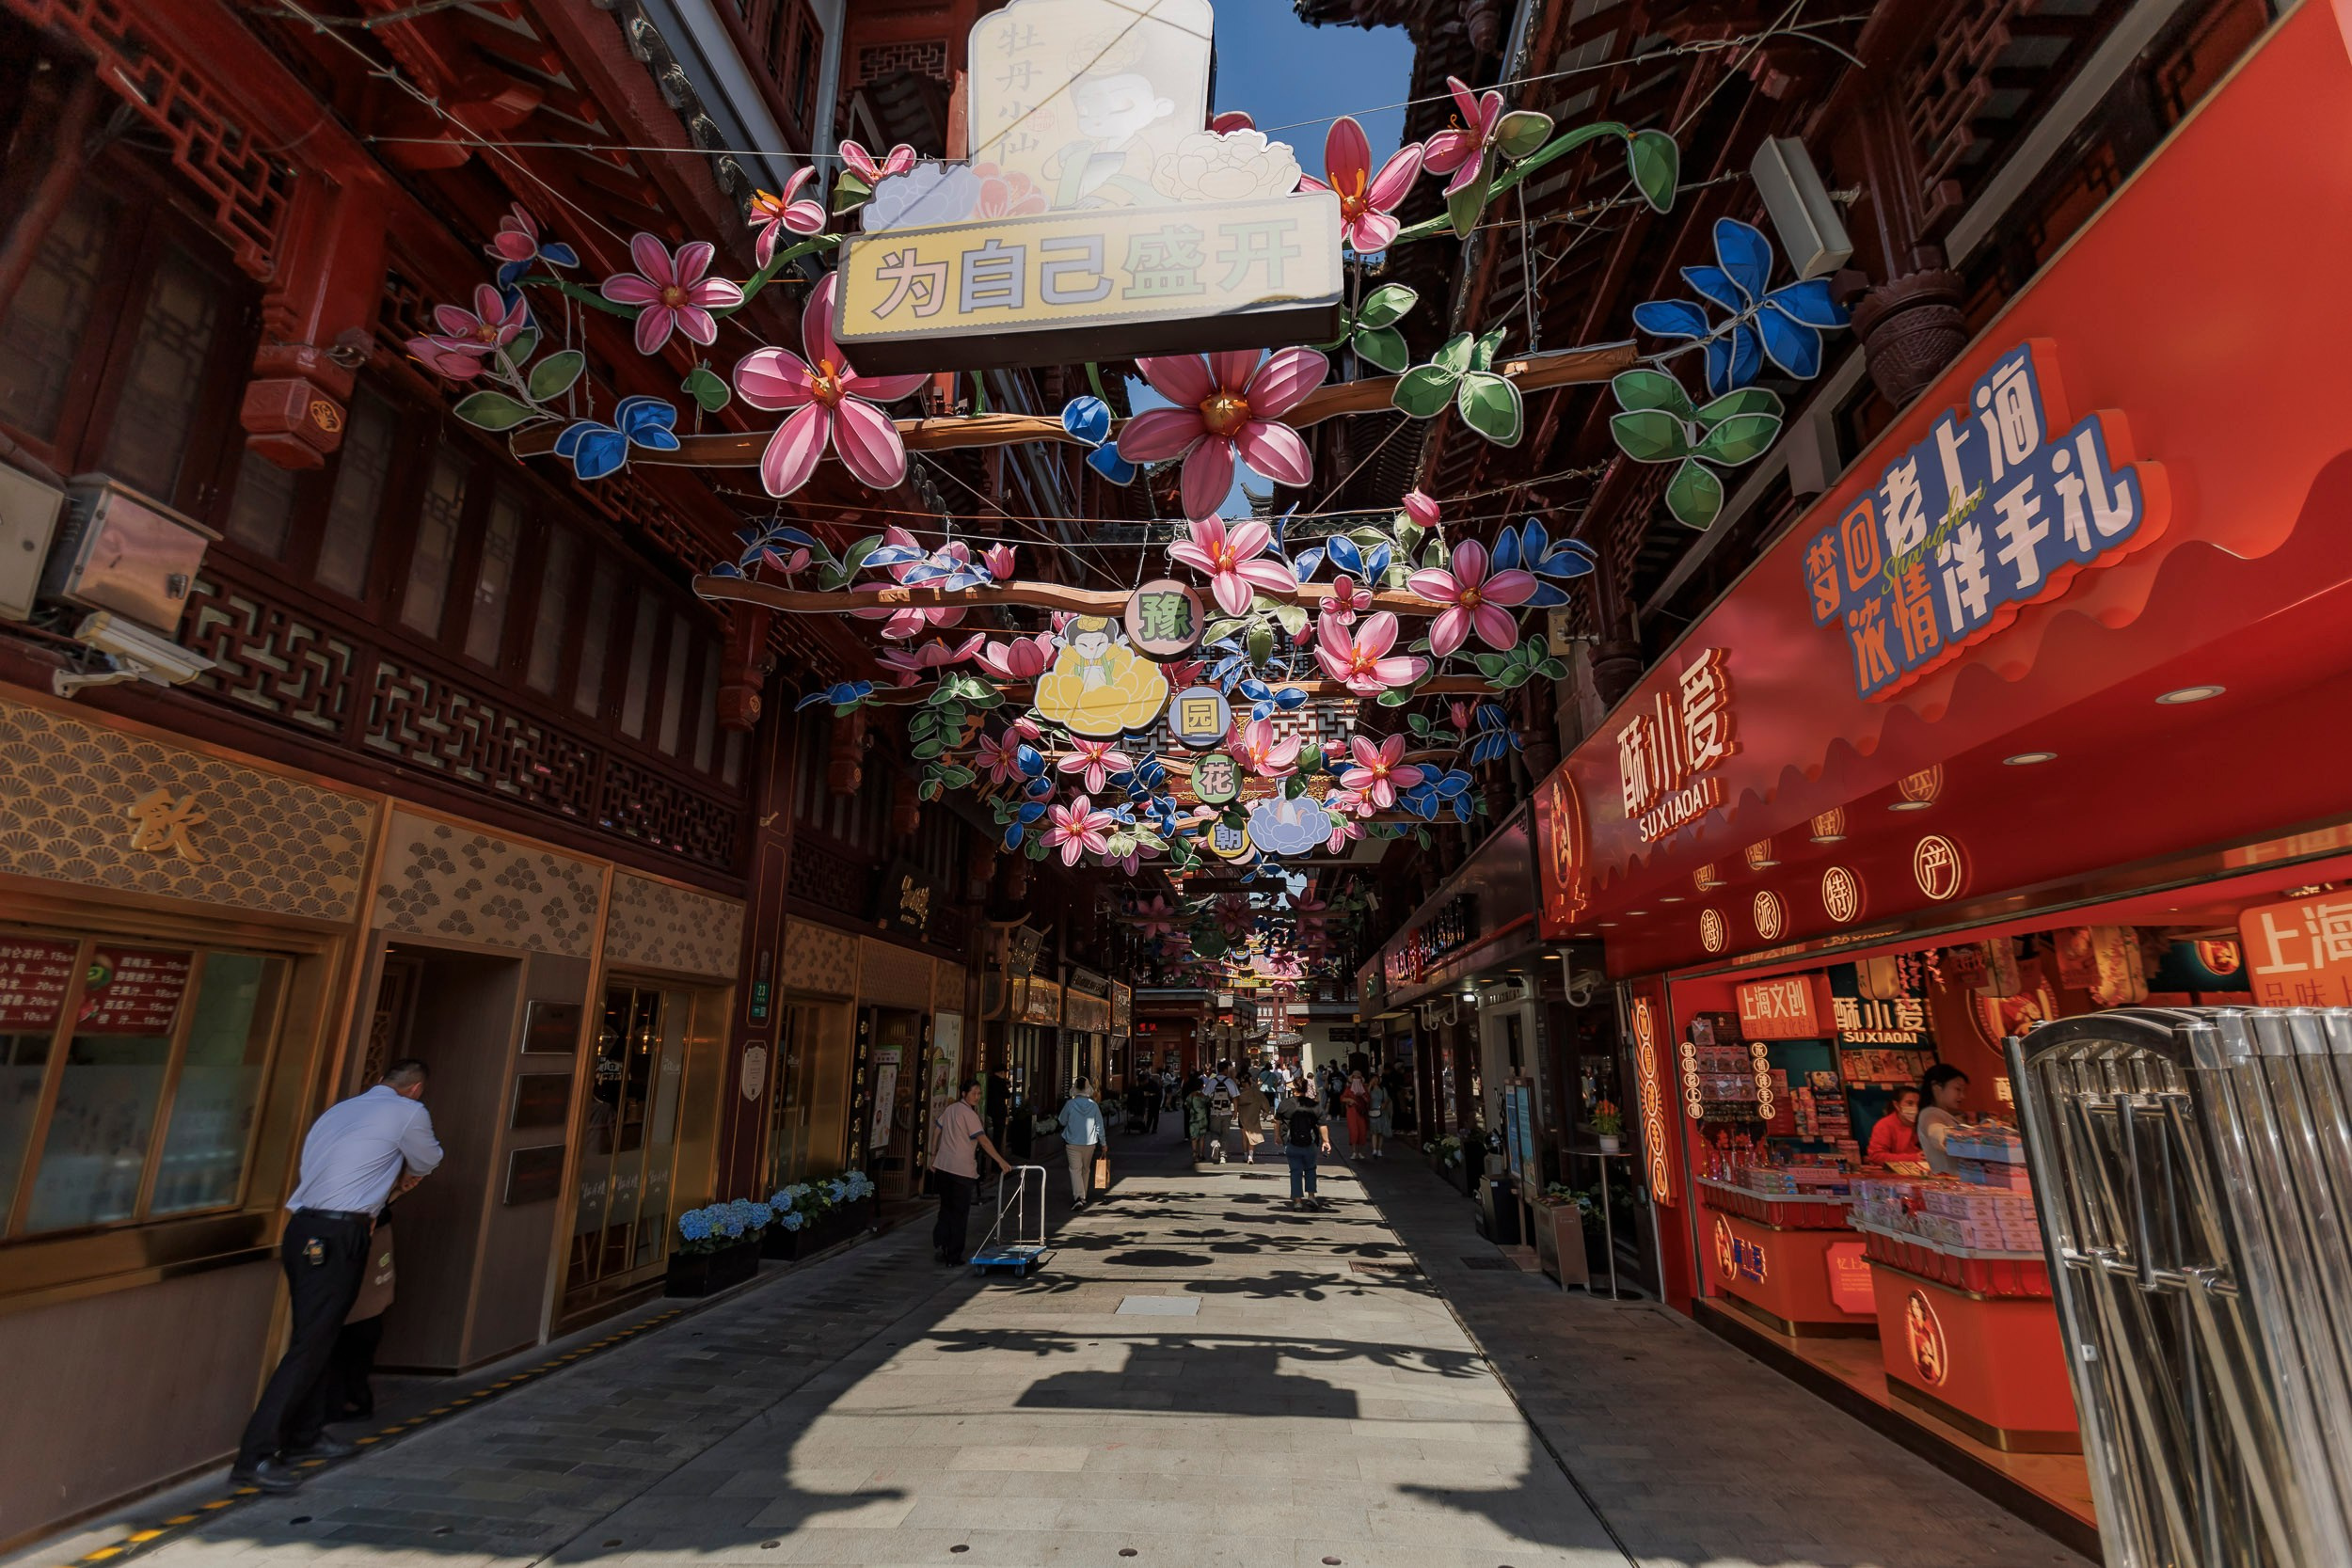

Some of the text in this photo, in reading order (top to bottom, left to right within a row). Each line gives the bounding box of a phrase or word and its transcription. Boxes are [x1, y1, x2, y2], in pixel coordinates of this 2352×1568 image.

[991, 23, 1045, 166] 牡丹小仙
[872, 218, 1302, 319] 为自己盛开
[1805, 355, 2041, 621] 梦回老上海
[1881, 479, 1987, 595] Shanghai
[1138, 592, 1194, 643] 豫
[1180, 696, 1220, 736] 园
[1617, 647, 1724, 819] 酥小爱
[1200, 762, 1234, 797] 花
[1214, 821, 1244, 851] 朝
[1639, 777, 1710, 844] SUXIAOAI
[2255, 903, 2352, 974] 上海
[757, 984, 766, 997] 23
[1742, 979, 1807, 1021] 上海文创
[1833, 997, 1927, 1032] 酥小爱
[1844, 1031, 1918, 1044] SUXIAOAI
